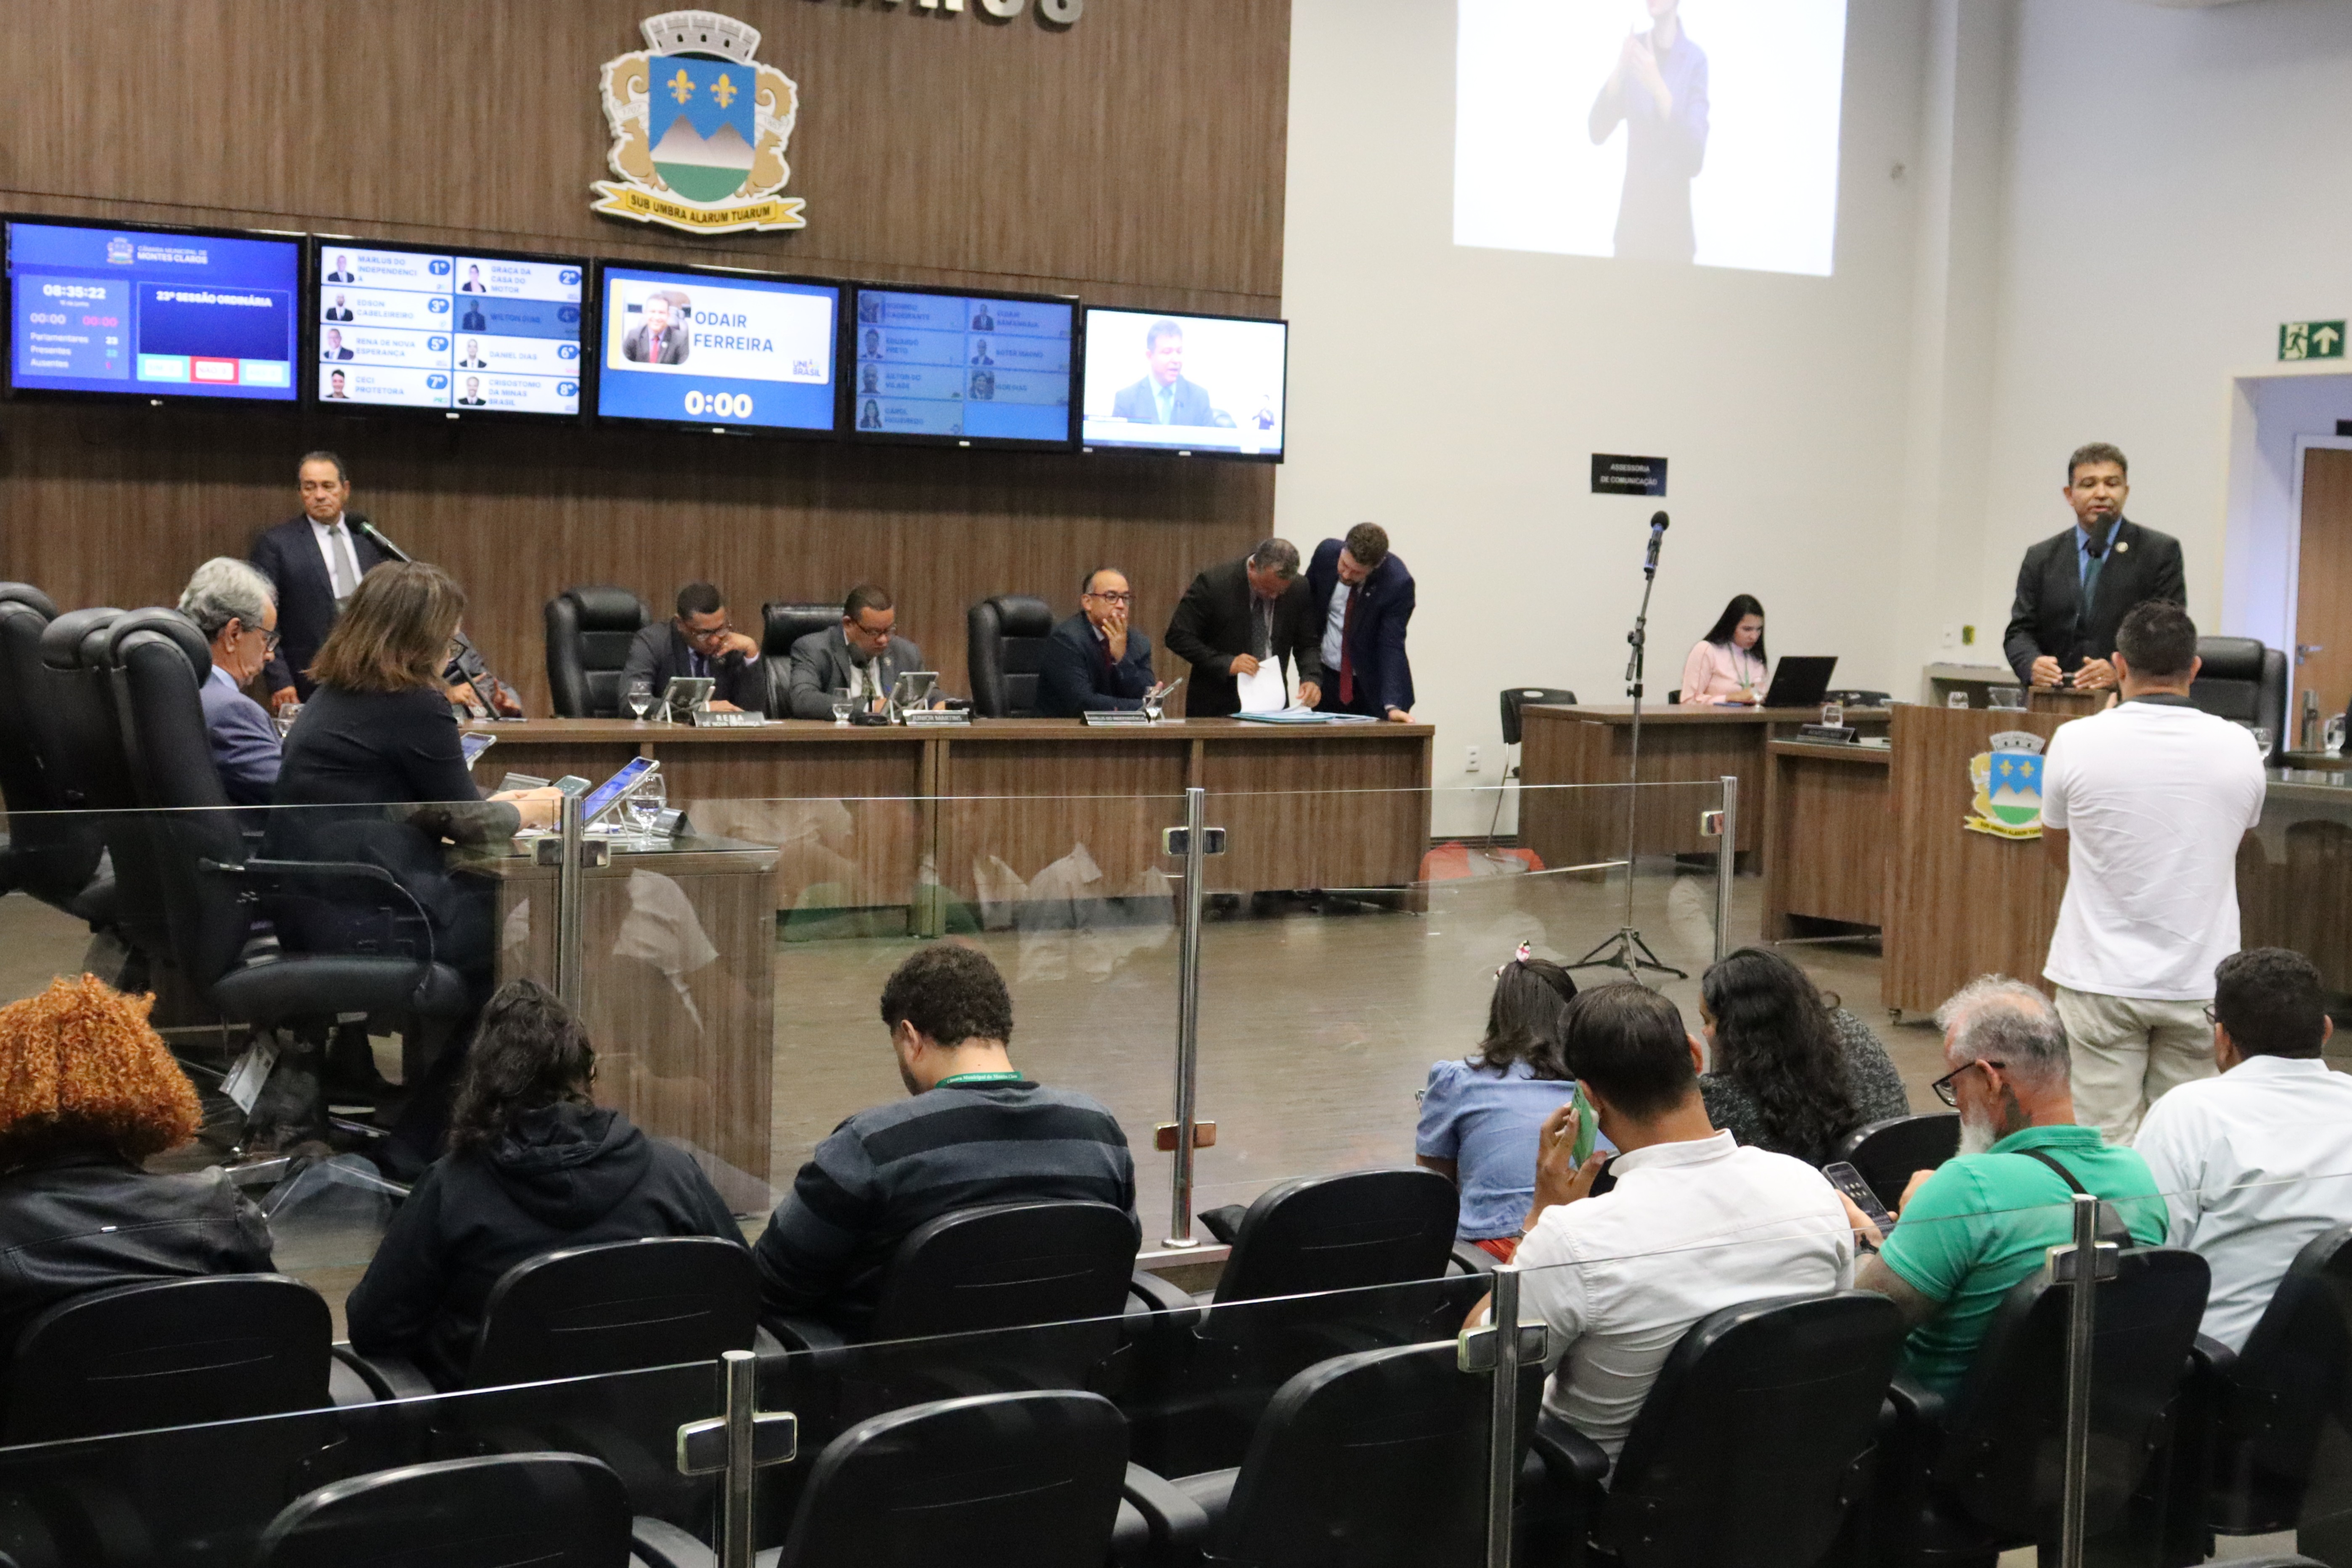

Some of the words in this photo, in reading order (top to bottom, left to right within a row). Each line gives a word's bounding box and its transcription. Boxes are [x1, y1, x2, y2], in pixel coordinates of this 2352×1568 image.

[631, 194, 650, 210] SUB
[653, 203, 686, 220] UMBRA
[689, 211, 728, 223] ALARUM
[731, 205, 770, 221] TUARUM
[137, 252, 173, 262] MONTES
[173, 254, 208, 264] CLAROS
[358, 255, 392, 264] MARLUS
[43, 284, 106, 300] 08:35:22
[175, 291, 216, 304] SESSÃO
[217, 294, 273, 307] ORDINÁRIA
[30, 313, 66, 324] 00:00
[82, 316, 119, 327] 00:00
[695, 311, 747, 328] ODAIR
[30, 332, 89, 344] Parlamentares
[694, 334, 774, 353] FERREIRA
[30, 345, 72, 356] Presentes
[30, 358, 69, 369] Ausentes
[355, 386, 404, 395] PROTETORA
[684, 390, 753, 418] 0:00
[1610, 463, 1650, 472] ASSESSORIA
[1610, 476, 1658, 486] COMUNICAÇÃO
